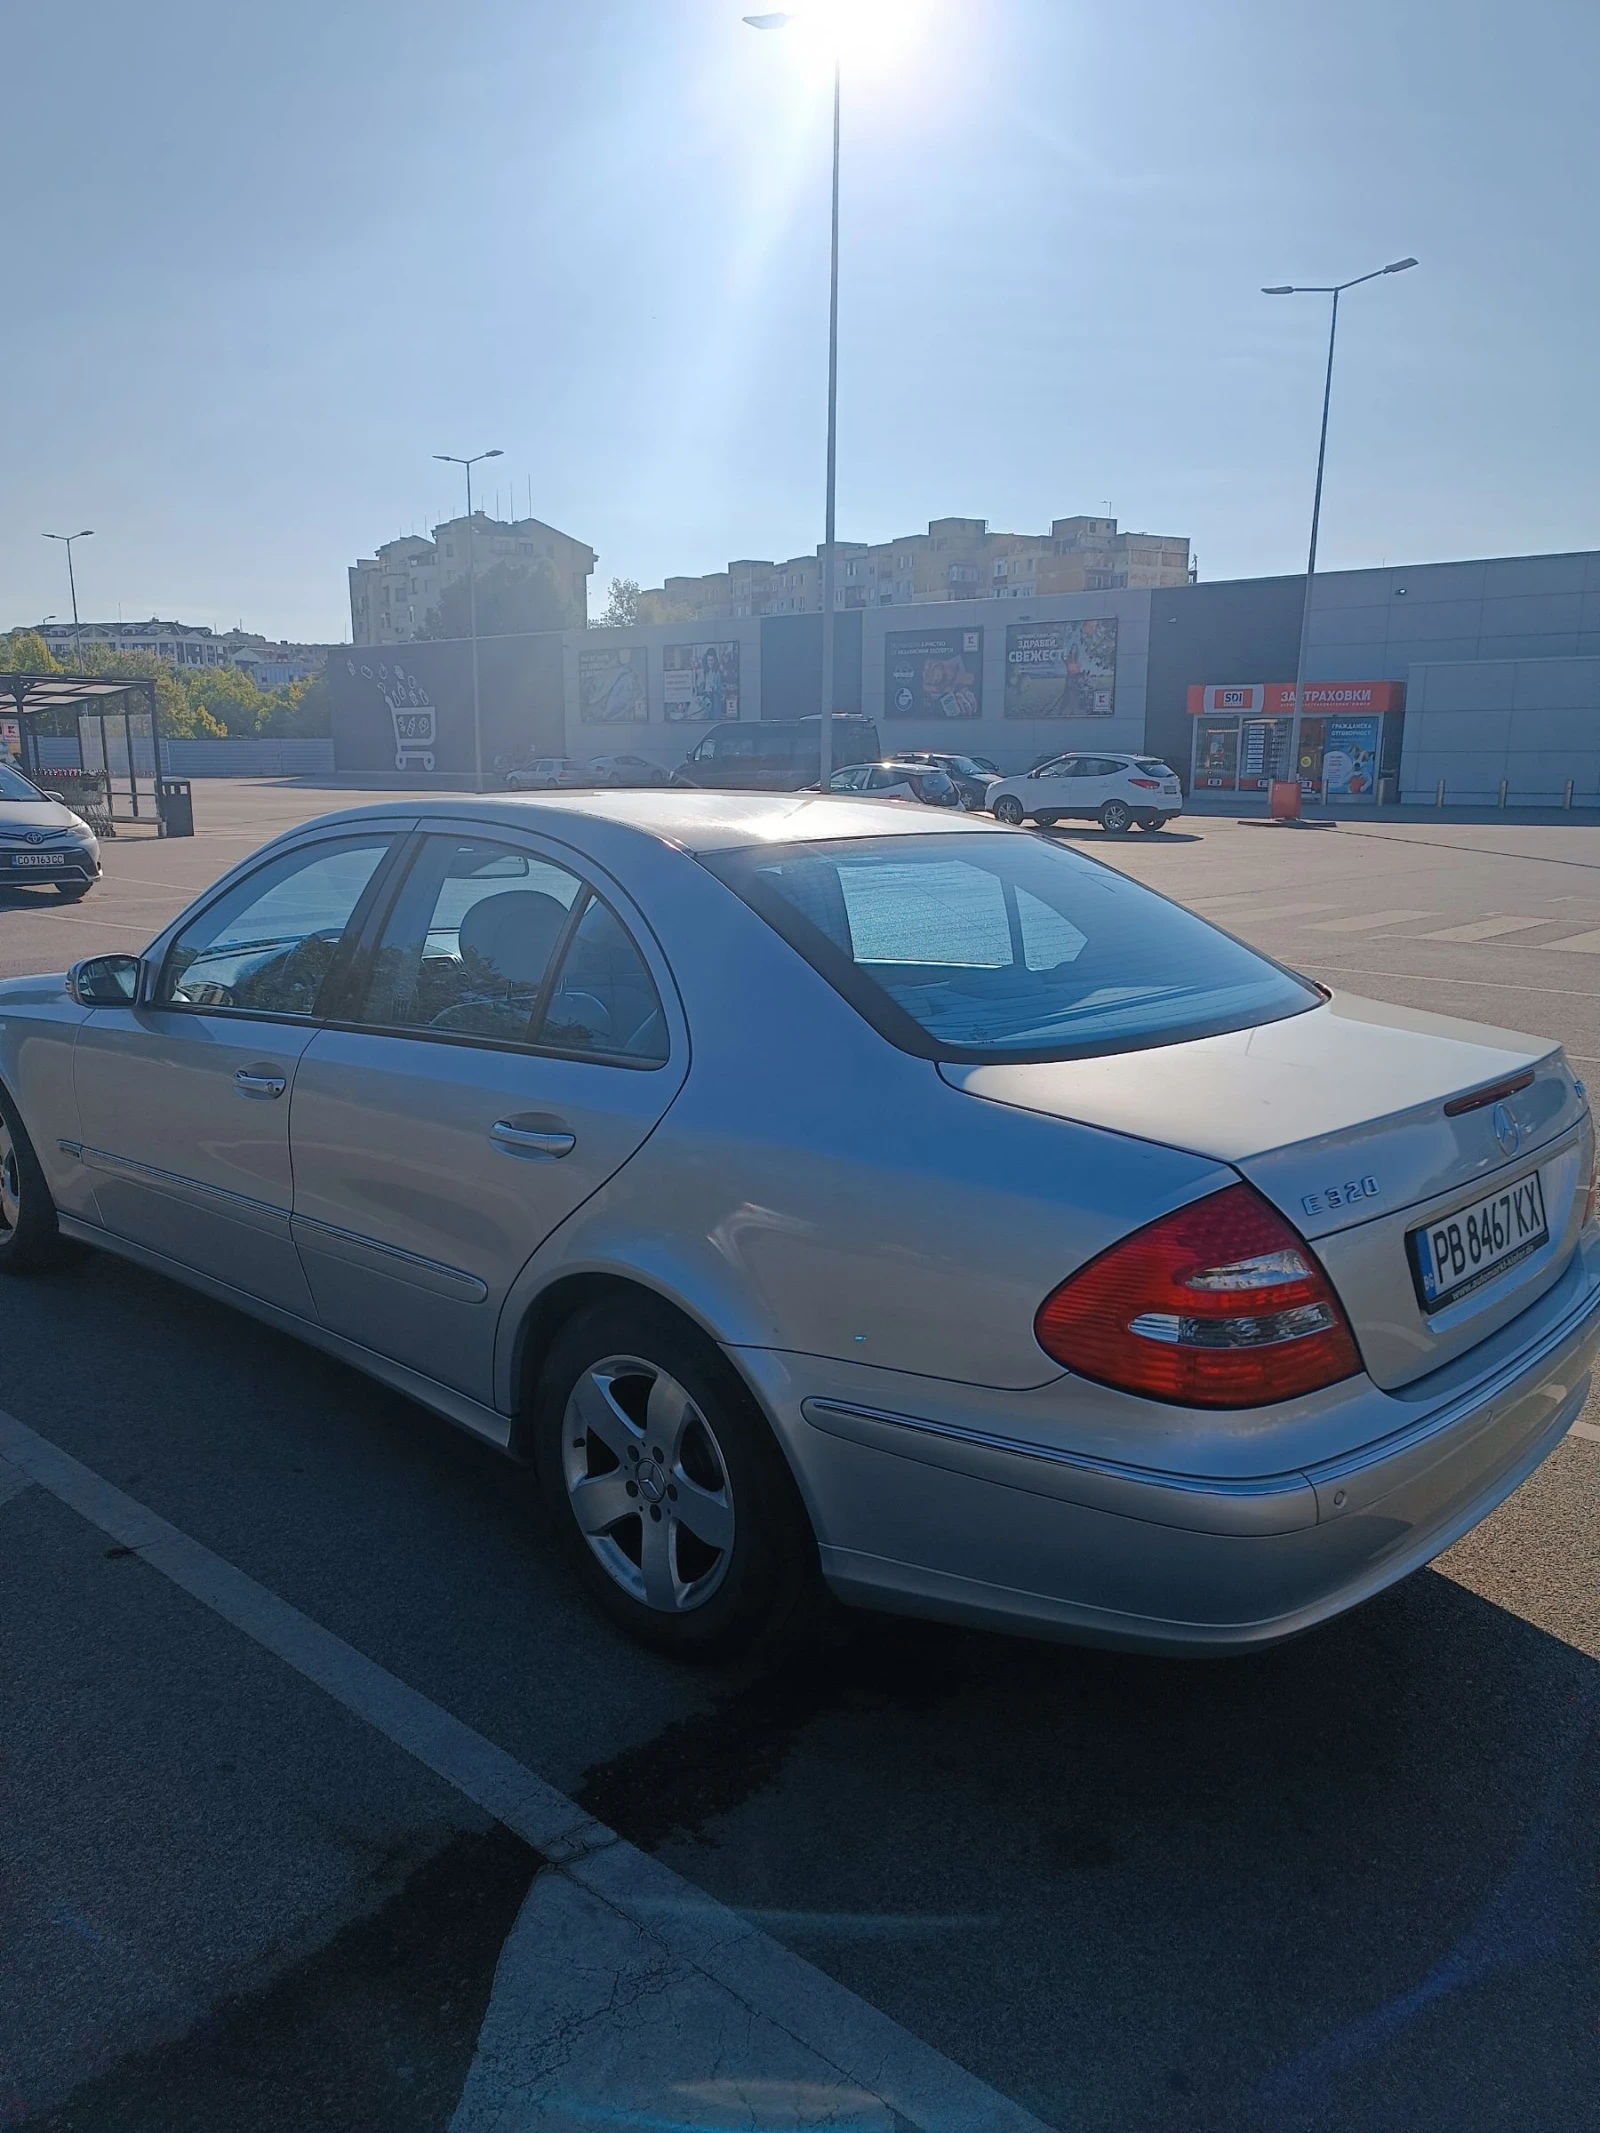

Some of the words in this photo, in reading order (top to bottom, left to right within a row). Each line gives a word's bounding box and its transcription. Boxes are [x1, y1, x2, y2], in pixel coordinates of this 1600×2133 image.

[1224, 692, 1243, 702] SDI
[1280, 689, 1372, 702] ЗАТРАХОВКИ
[30, 855, 51, 864] 9163
[1301, 1193, 1323, 1217] E
[1325, 1174, 1381, 1210] 320
[1432, 1223, 1466, 1284] PB
[1466, 1195, 1511, 1264] 8467
[1513, 1181, 1541, 1238] KX
[1423, 1272, 1435, 1291] BG
